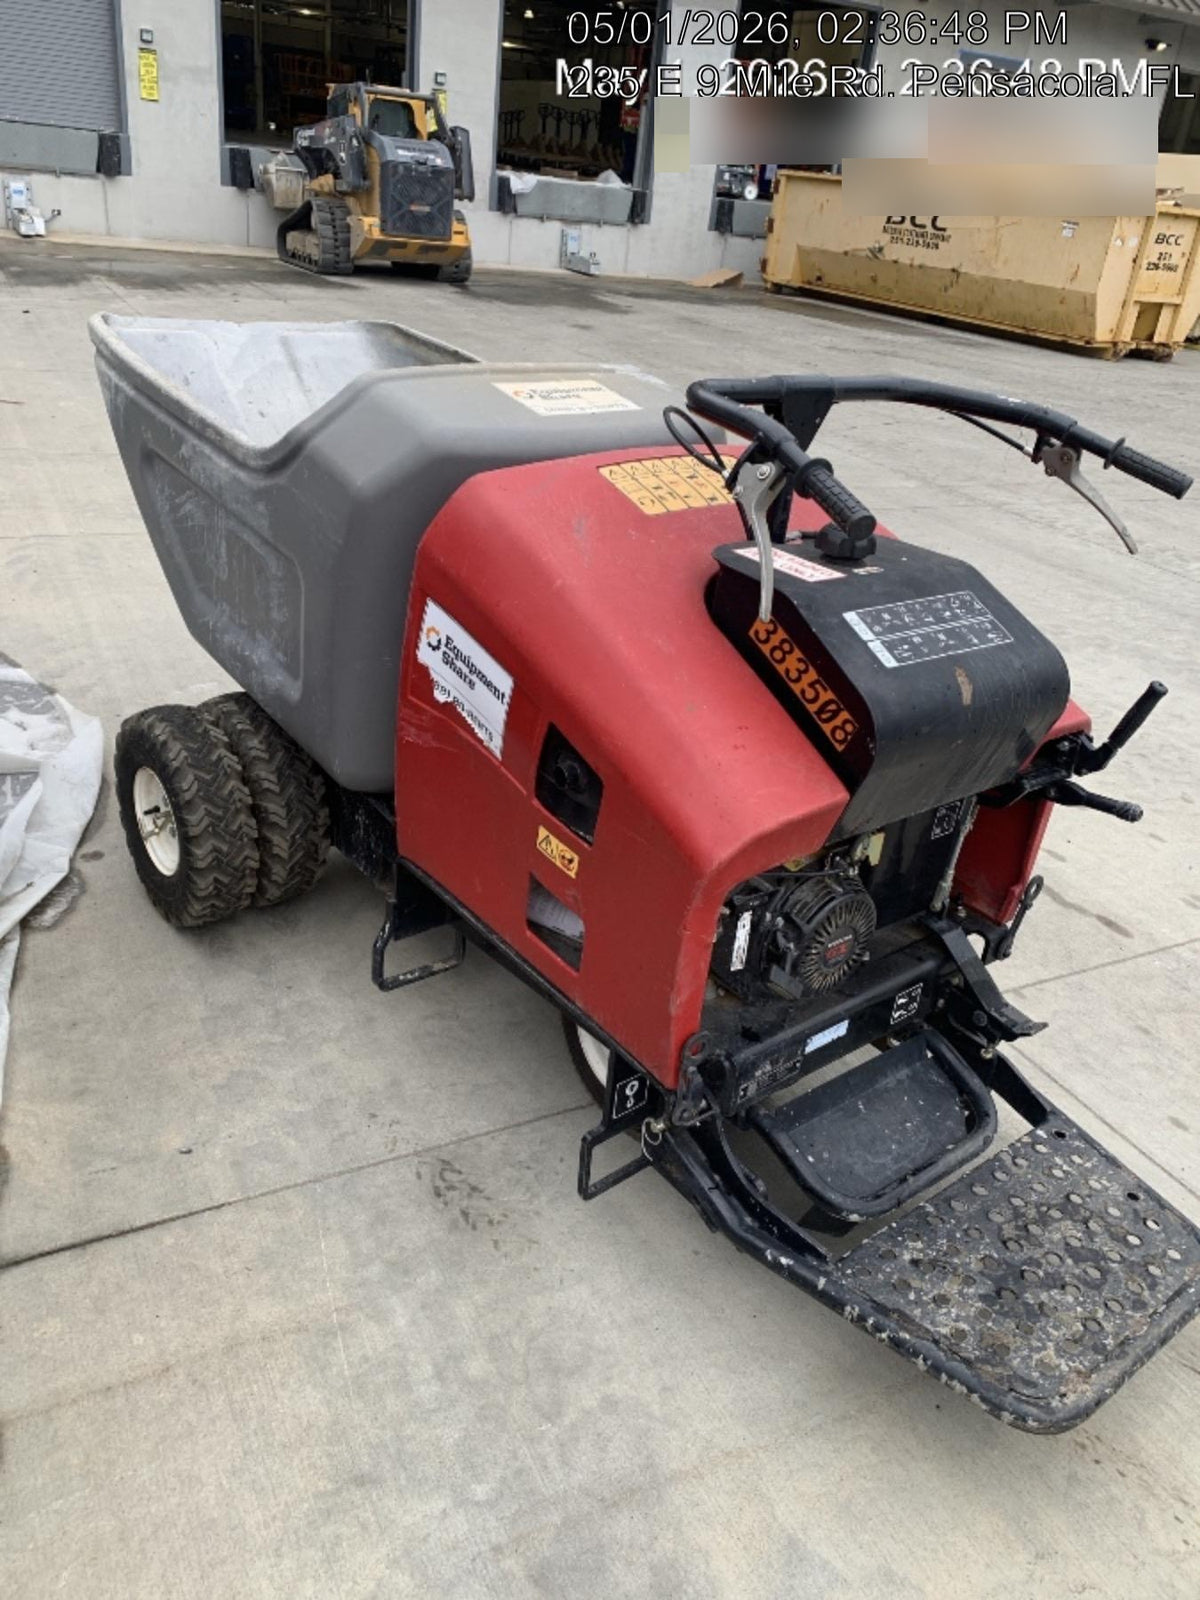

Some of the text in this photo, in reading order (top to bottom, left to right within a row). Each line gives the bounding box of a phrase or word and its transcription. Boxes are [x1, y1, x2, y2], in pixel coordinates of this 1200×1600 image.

[1154, 232, 1184, 246] BCC
[441, 651, 476, 690] Share
[444, 634, 507, 705] Equipment
[753, 617, 856, 745] 383508
